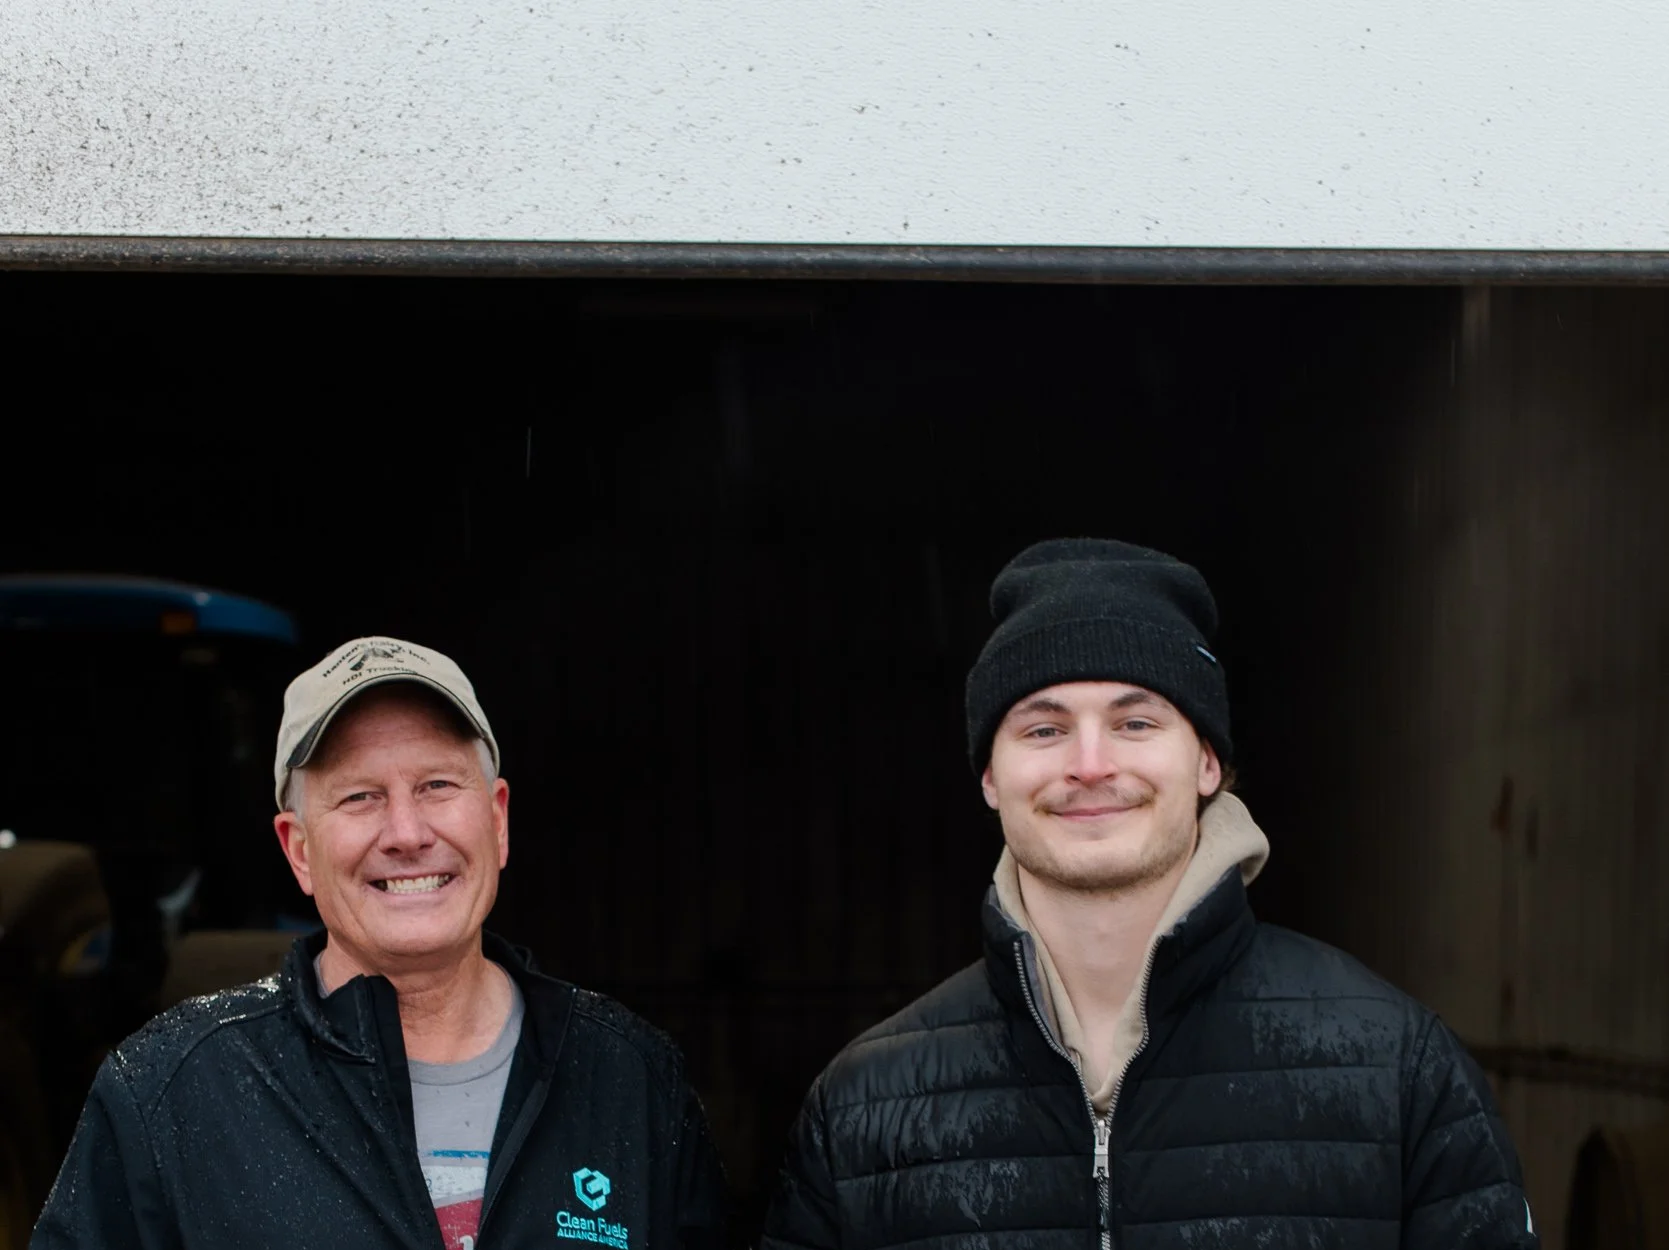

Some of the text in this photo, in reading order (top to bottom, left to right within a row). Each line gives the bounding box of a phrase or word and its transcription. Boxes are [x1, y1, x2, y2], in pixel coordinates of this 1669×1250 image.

[556, 1210, 628, 1240] Clean Fuels
[557, 1228, 629, 1250] ALLIANCE AMERICA
